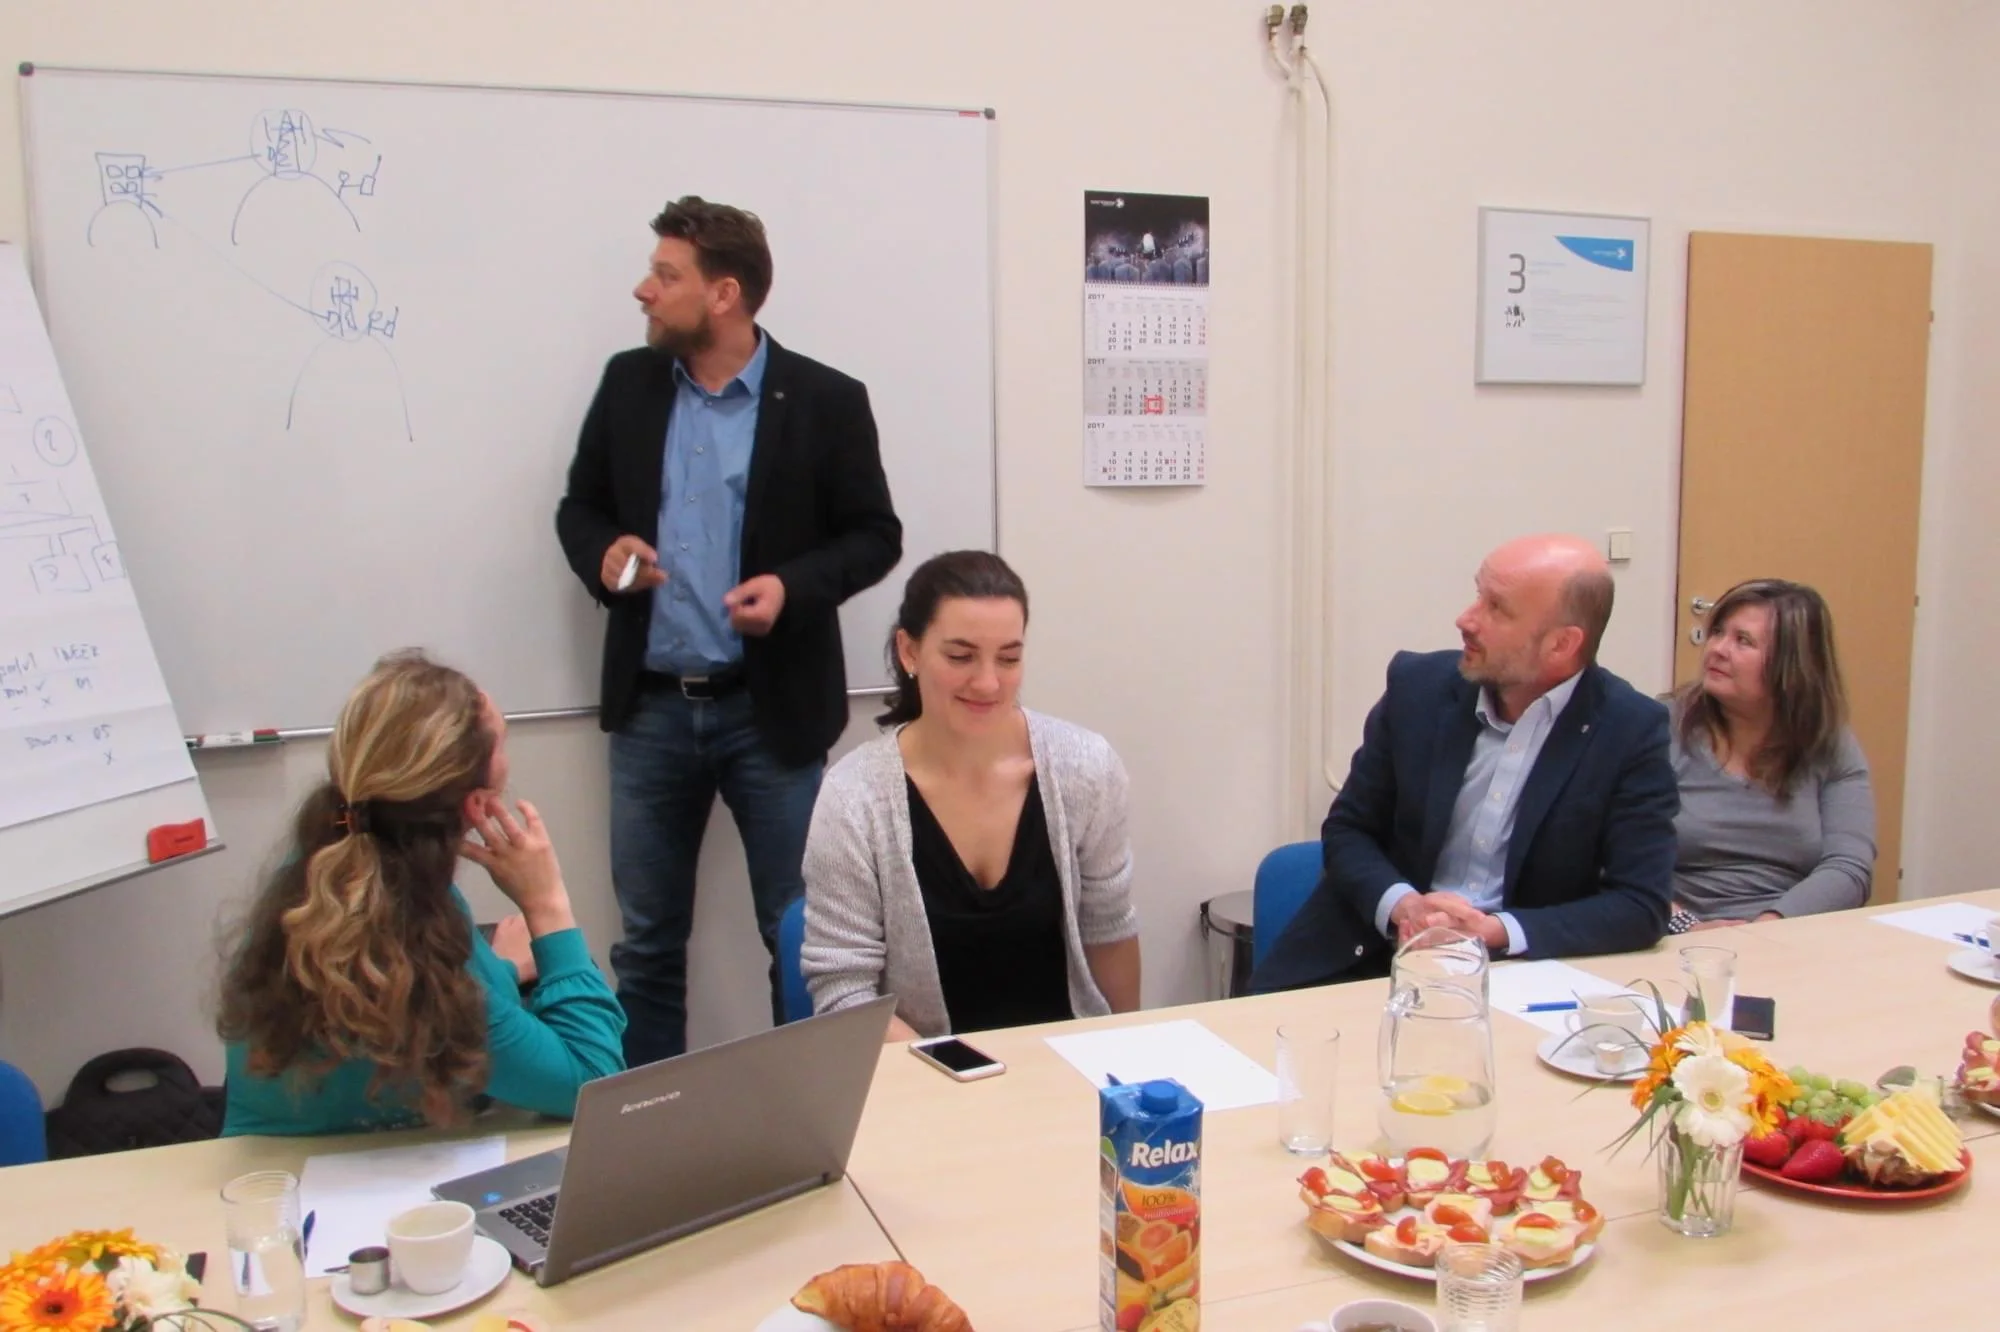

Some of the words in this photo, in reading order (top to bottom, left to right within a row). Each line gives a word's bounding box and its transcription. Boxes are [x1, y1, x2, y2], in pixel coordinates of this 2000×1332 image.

[1507, 253, 1526, 294] 3
[620, 1090, 681, 1114] lenovo
[1131, 1139, 1198, 1169] Relax
[1141, 1192, 1177, 1208] 100%
